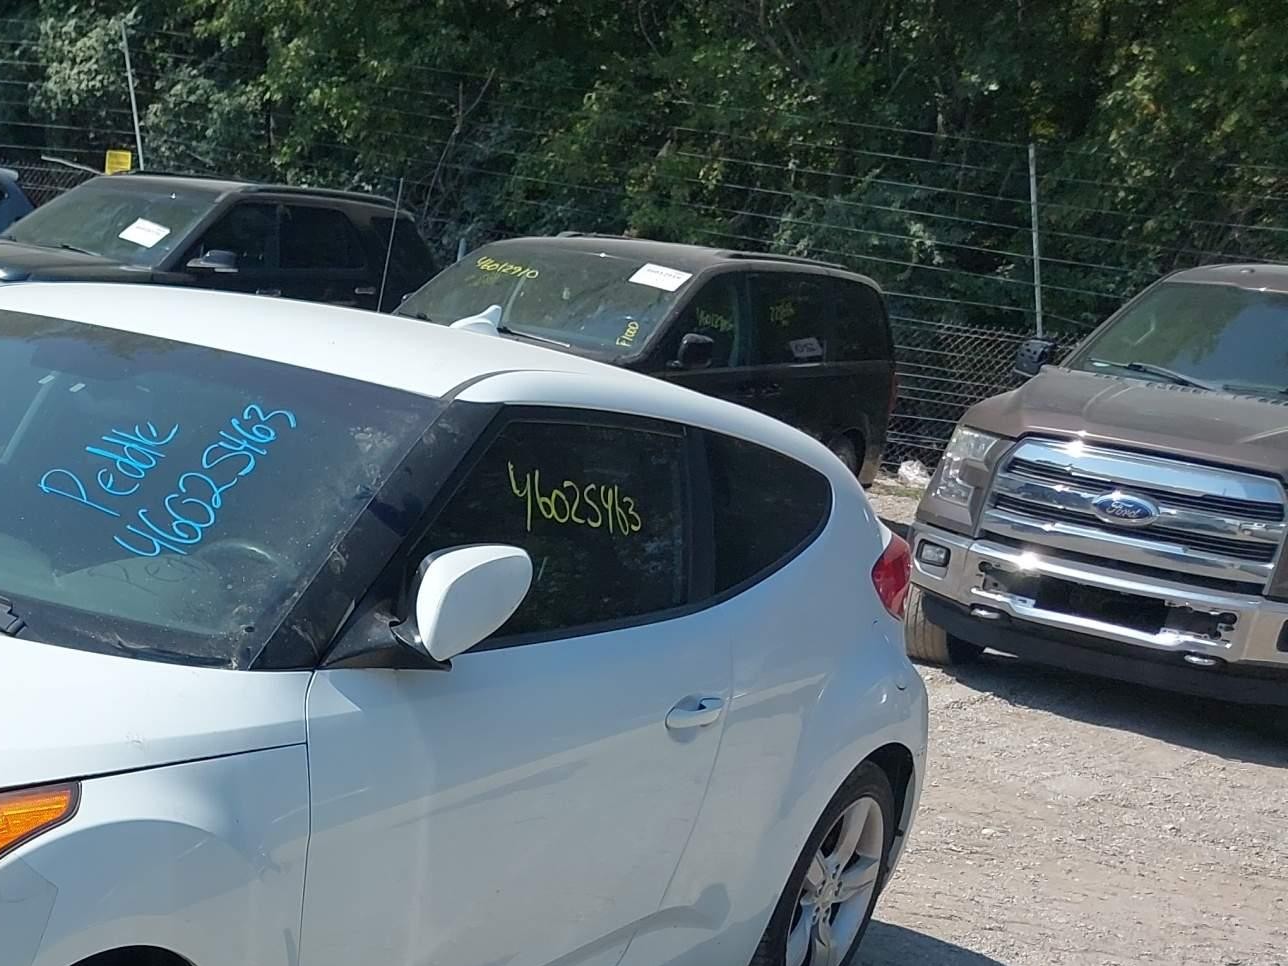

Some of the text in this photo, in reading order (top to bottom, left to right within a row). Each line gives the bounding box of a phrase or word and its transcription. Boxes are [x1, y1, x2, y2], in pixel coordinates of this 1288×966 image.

[476, 256, 539, 279] 46012910
[113, 404, 297, 557] 46025463
[507, 460, 642, 536] 46025463
[1105, 500, 1143, 518] Ford
